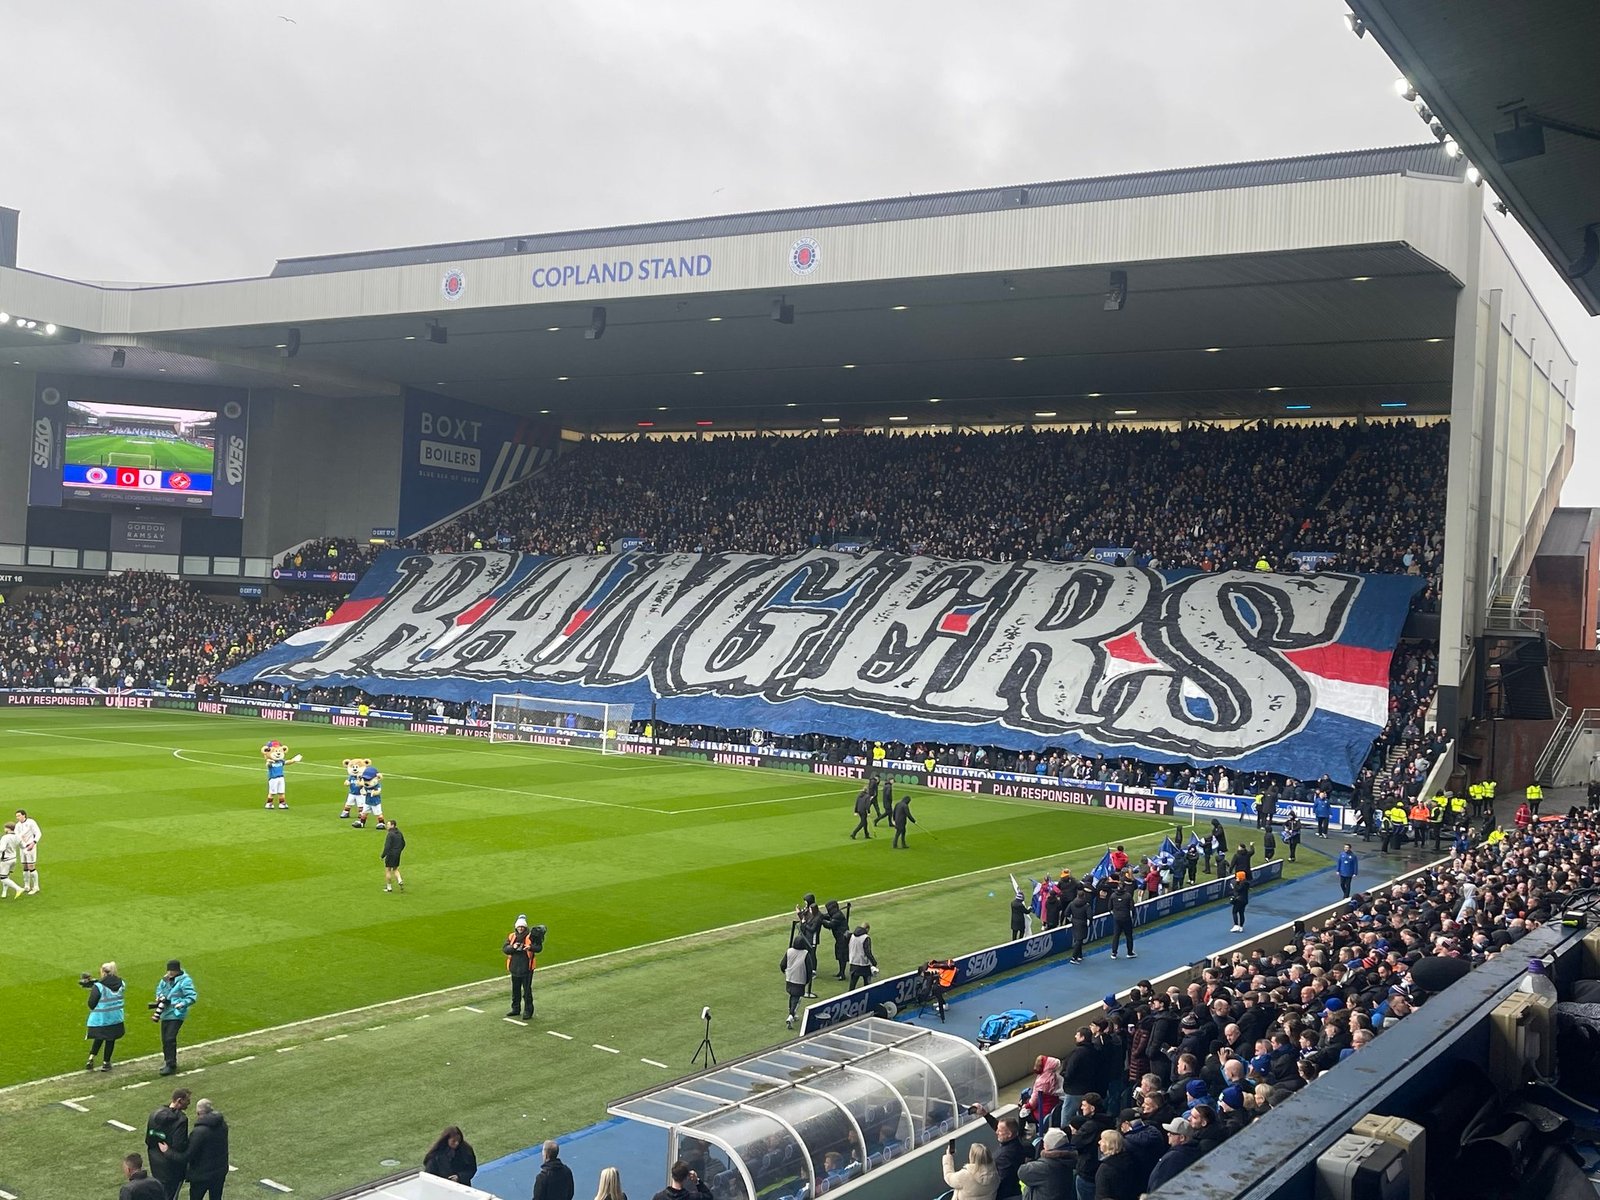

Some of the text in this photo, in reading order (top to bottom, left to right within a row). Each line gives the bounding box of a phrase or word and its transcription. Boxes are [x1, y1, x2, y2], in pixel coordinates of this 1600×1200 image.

[532, 255, 712, 288] COPLAND STAND
[422, 412, 482, 442] BOXT
[34, 417, 53, 468] SEKO
[227, 435, 244, 486] SEKO
[426, 447, 476, 466] BOILERS
[122, 472, 155, 486] 0 0
[255, 547, 1365, 760] RANGERS
[8, 696, 96, 706] PLAY RESPONSIBLY
[105, 696, 153, 708] UNIBET
[198, 702, 227, 714] UNIBET
[261, 708, 294, 720] UNIBET
[332, 716, 368, 727] UNIBET
[410, 723, 448, 734] UNIBET
[530, 734, 570, 746] UNIBET
[618, 744, 662, 756] UNIBET
[715, 753, 760, 767] UNIBET
[814, 764, 864, 779] UNIBET
[927, 775, 982, 793] UNIBET
[993, 784, 1093, 806] PLAY RESPONSIBLY
[1174, 792, 1215, 808] William
[1214, 796, 1237, 809] HILL
[1105, 795, 1167, 814] UNIBET
[1024, 934, 1052, 958] SEKO
[966, 951, 998, 977] SEKO
